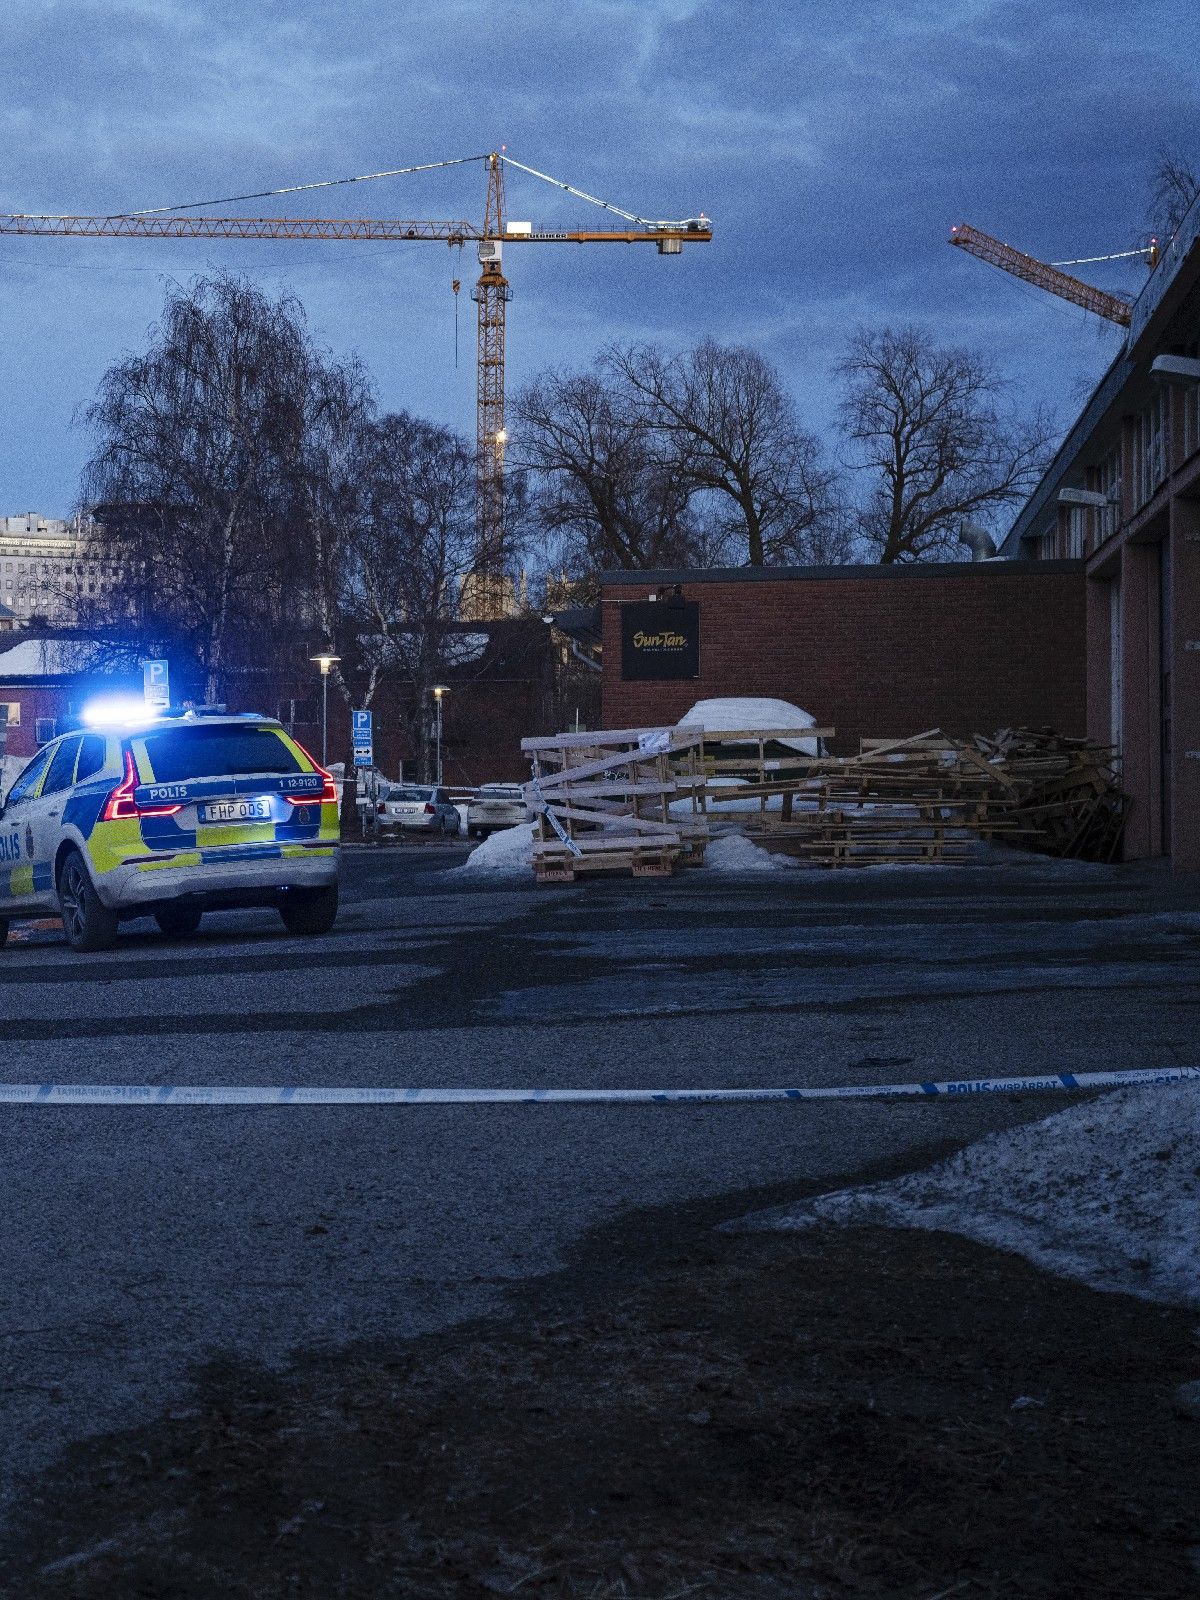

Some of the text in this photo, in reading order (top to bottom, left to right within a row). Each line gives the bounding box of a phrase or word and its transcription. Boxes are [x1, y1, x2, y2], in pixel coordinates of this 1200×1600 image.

[151, 663, 164, 683] P
[357, 712, 368, 728] P
[278, 778, 317, 788] 1 12-9120
[149, 786, 187, 800] POLIS
[209, 805, 235, 818] FHP
[947, 1082, 990, 1094] POLIS
